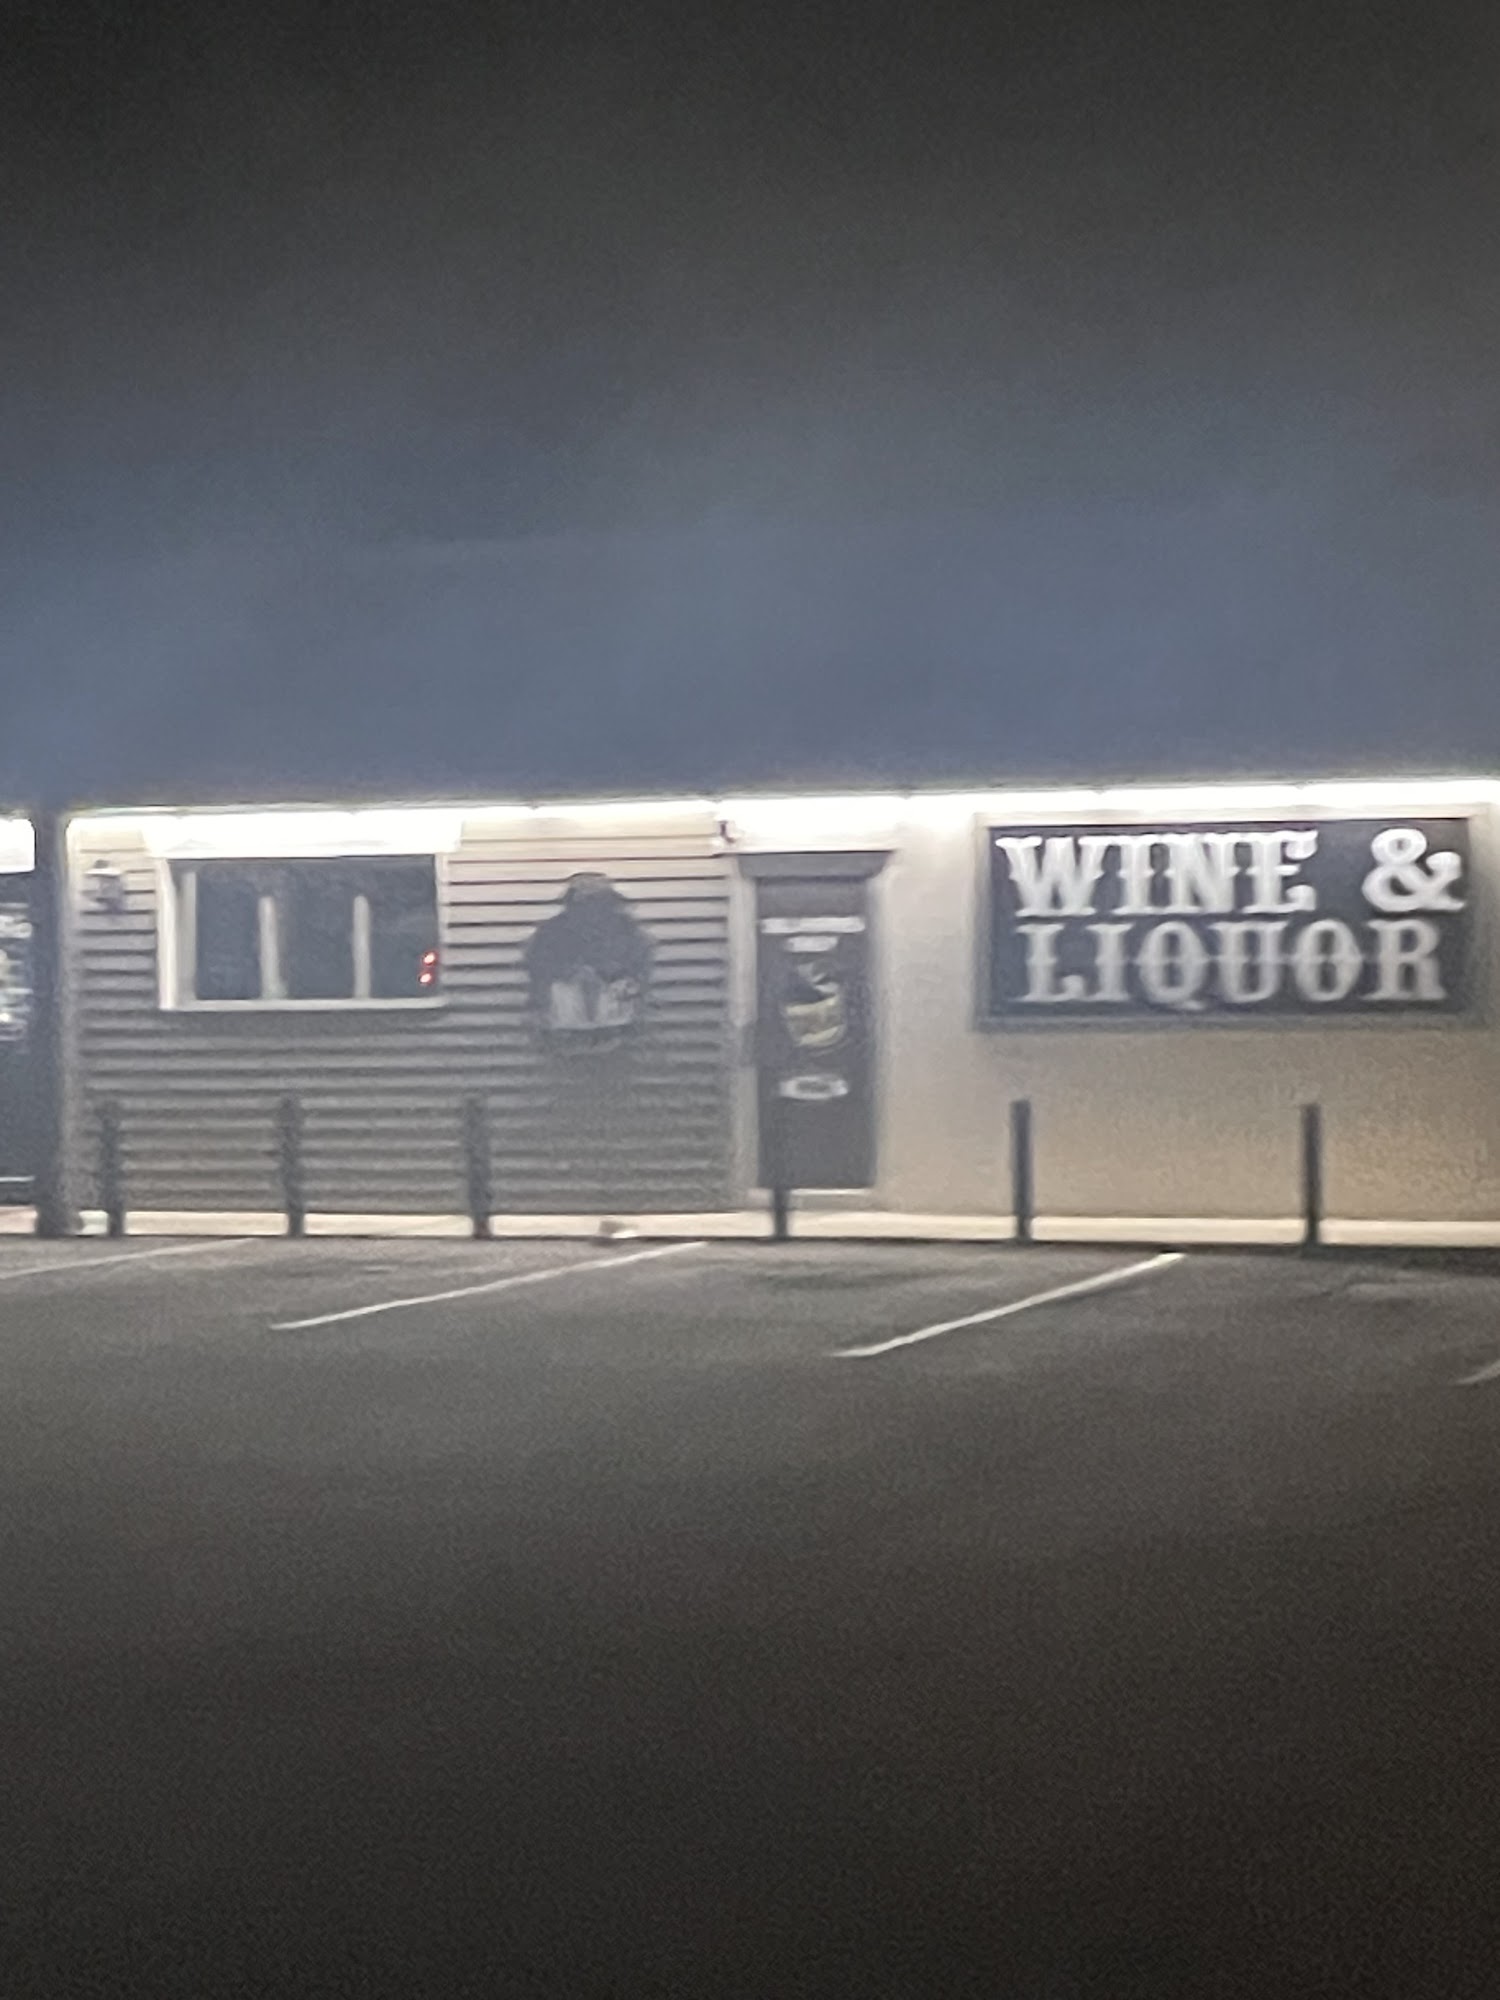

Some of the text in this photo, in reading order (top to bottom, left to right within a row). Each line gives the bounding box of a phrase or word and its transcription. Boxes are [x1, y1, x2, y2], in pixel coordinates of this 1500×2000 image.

[996, 828, 1466, 916] WINE &
[1010, 919, 1447, 1009] LIQUOR
